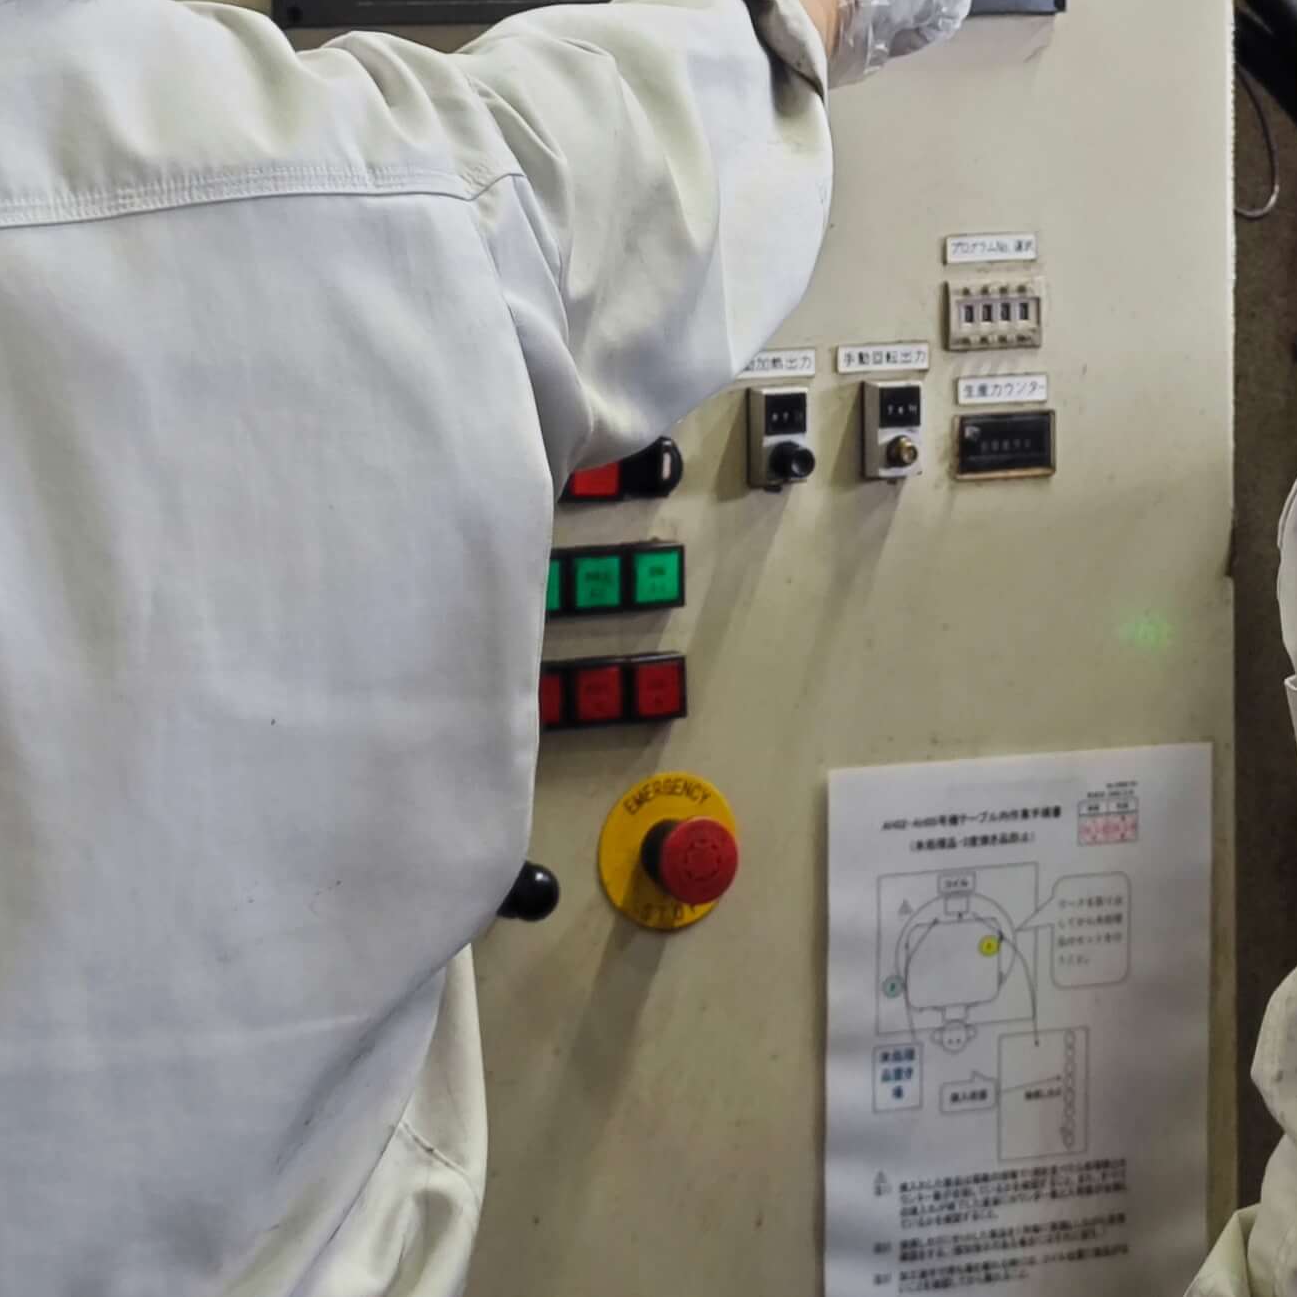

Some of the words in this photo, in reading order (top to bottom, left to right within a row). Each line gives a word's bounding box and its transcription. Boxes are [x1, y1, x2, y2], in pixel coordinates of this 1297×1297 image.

[963, 380, 1046, 398] 生産カウンター
[623, 777, 712, 815] EMERGENCY
